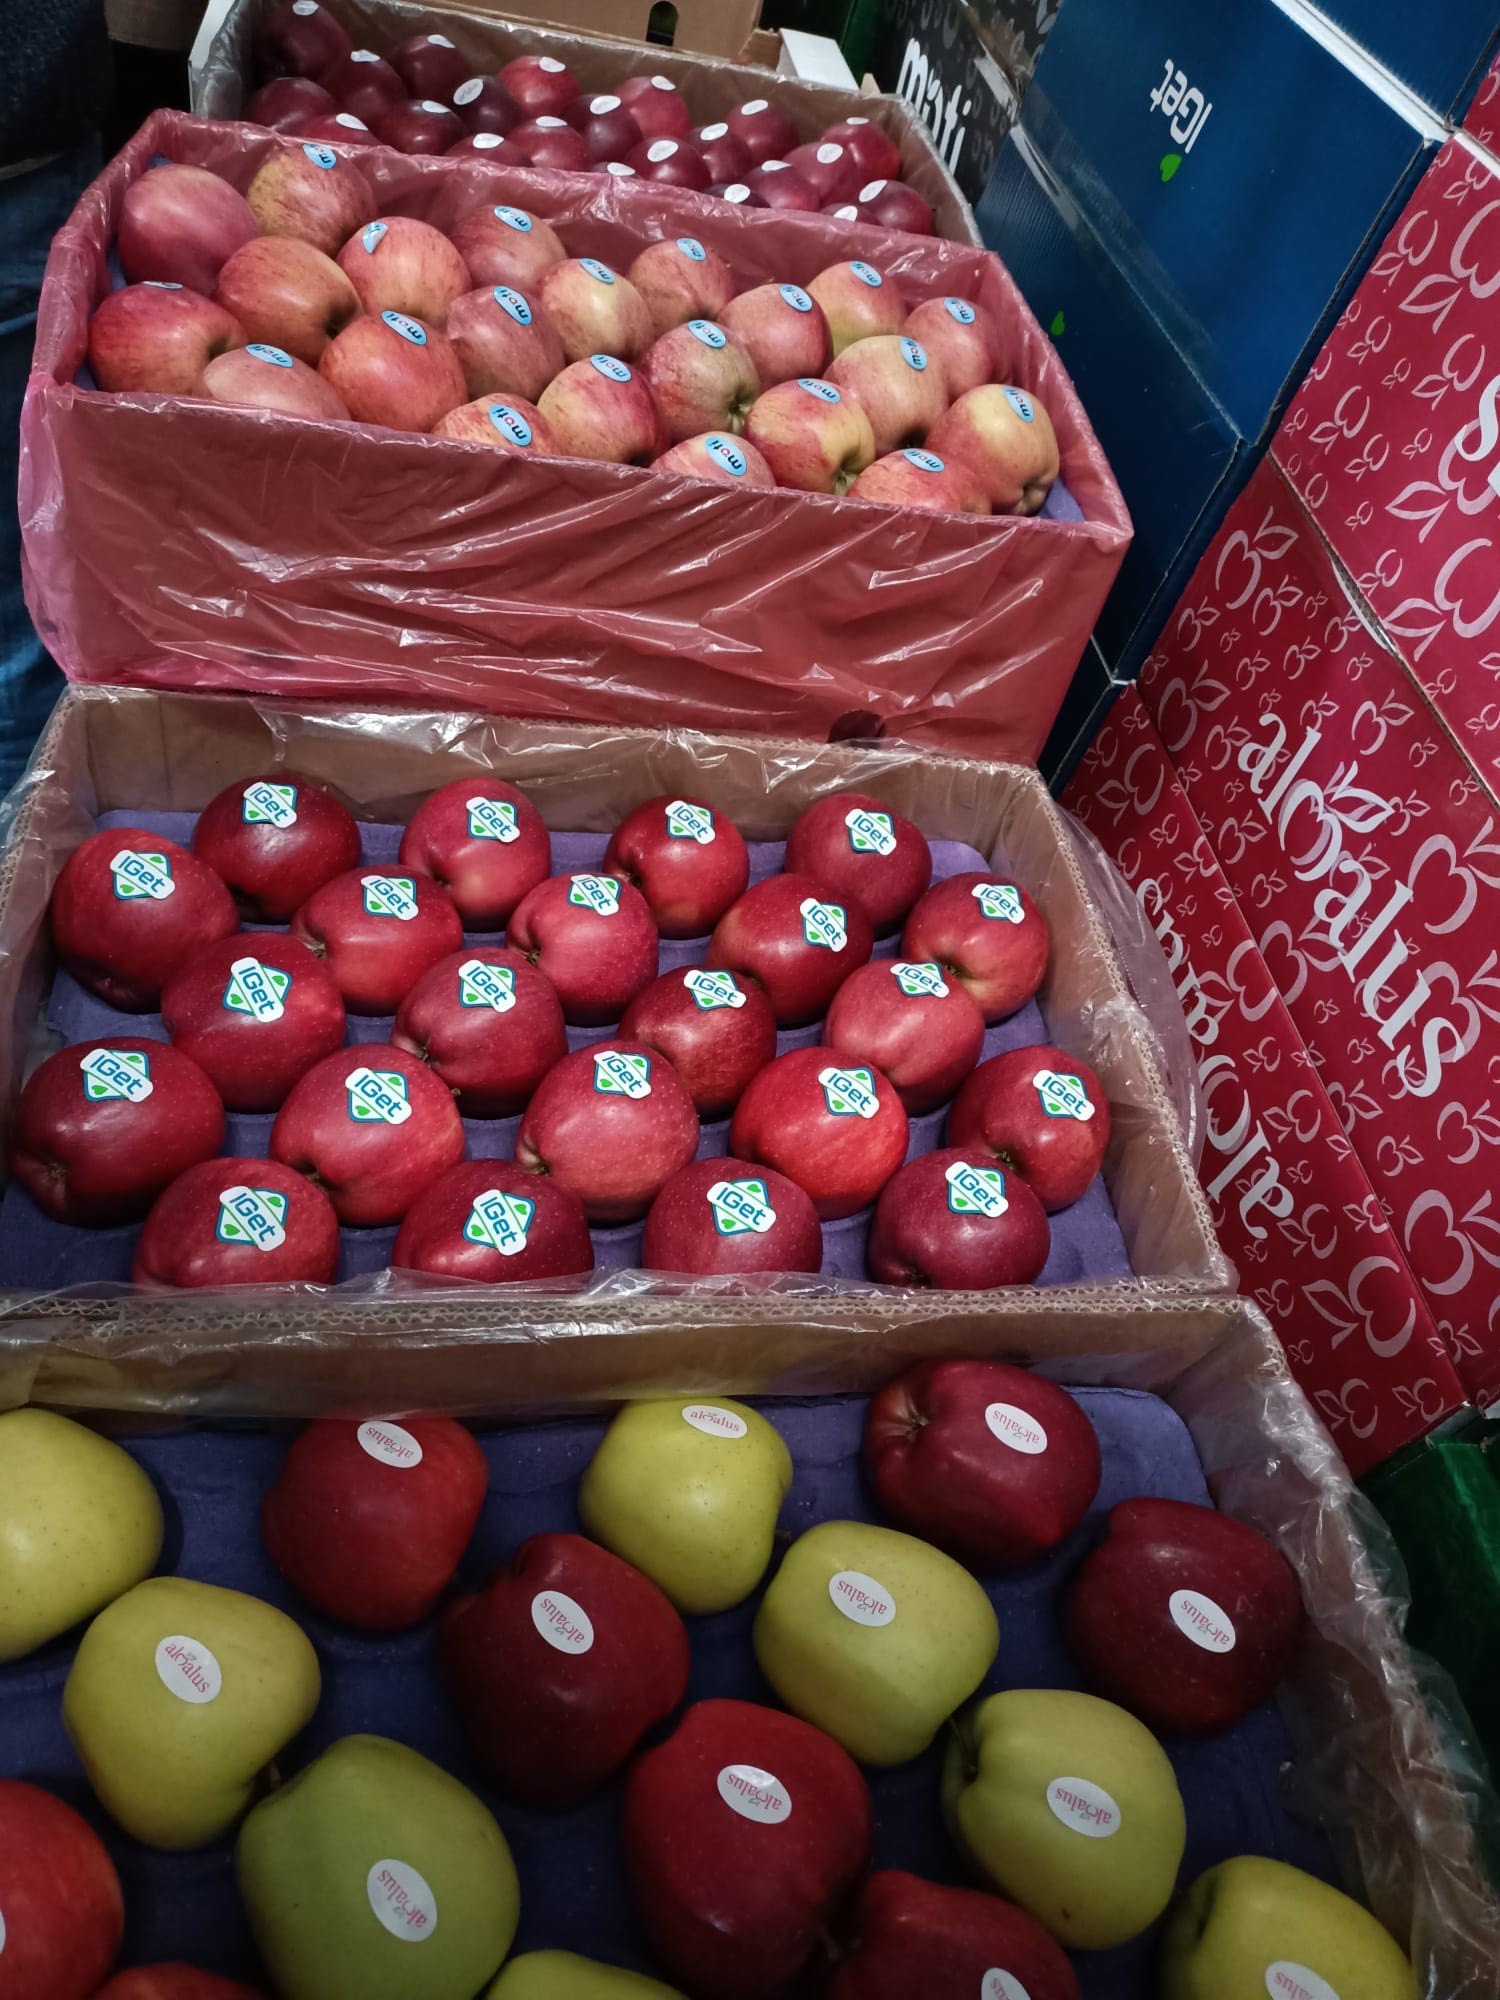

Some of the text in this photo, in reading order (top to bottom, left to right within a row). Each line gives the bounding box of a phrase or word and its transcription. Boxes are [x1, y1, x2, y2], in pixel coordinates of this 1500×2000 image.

[497, 287, 529, 319] moti
[387, 313, 422, 340] moti
[492, 406, 528, 441] moti
[705, 438, 743, 470] moti
